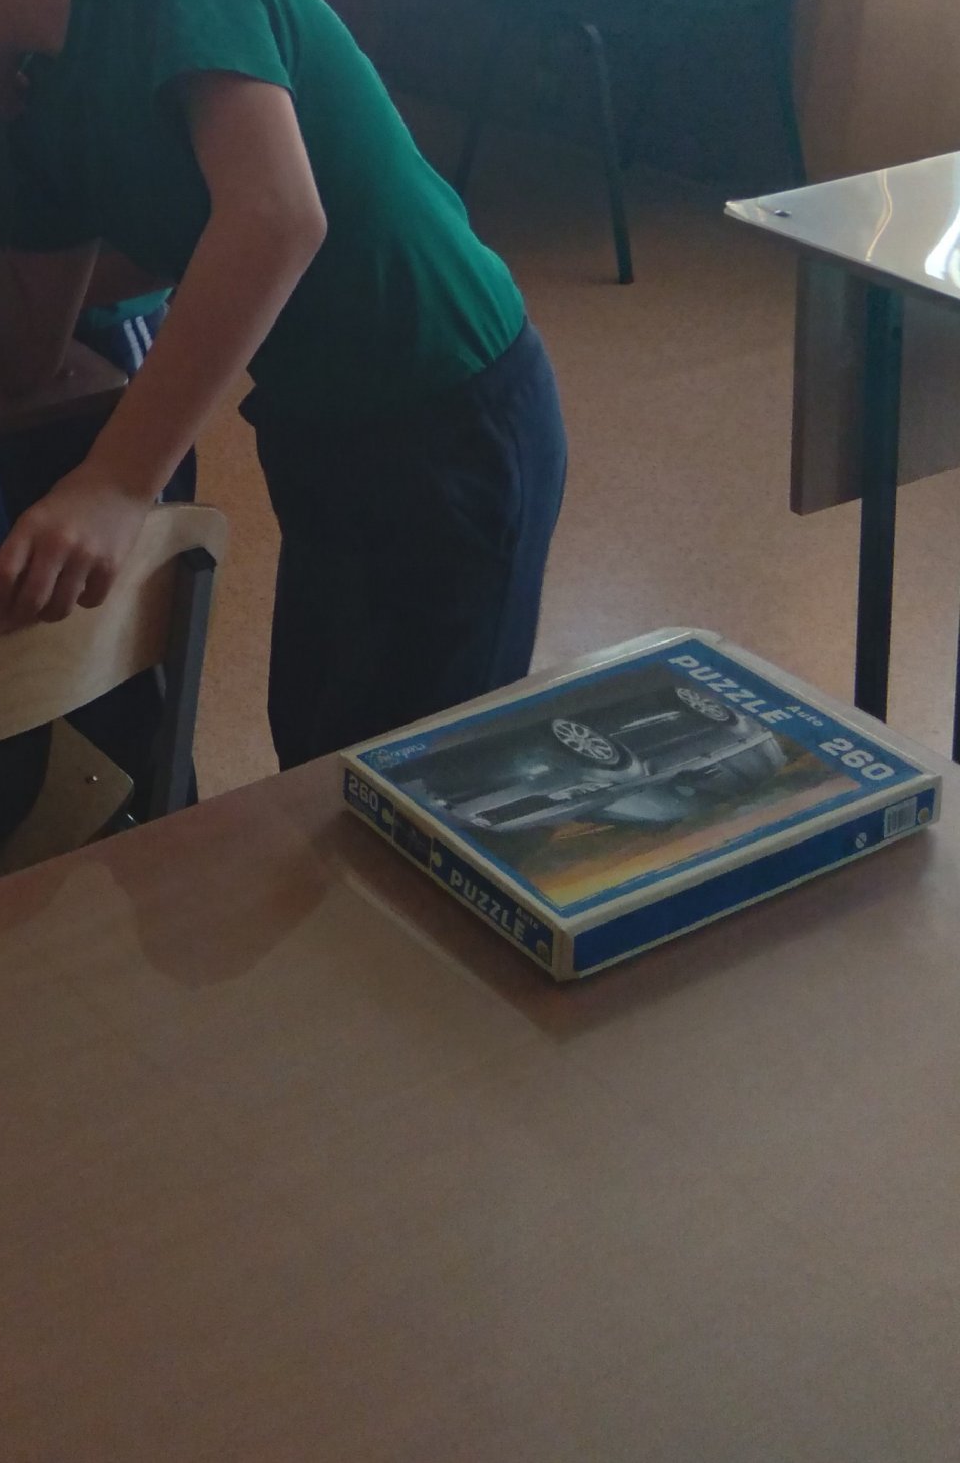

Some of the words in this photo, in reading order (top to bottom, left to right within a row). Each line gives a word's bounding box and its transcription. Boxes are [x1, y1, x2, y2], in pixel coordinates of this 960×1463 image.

[667, 655, 793, 724] PUZZLE
[786, 705, 824, 727] Auto
[818, 738, 895, 781] 260
[348, 773, 380, 812] 260
[450, 867, 526, 941] PUZZLE
